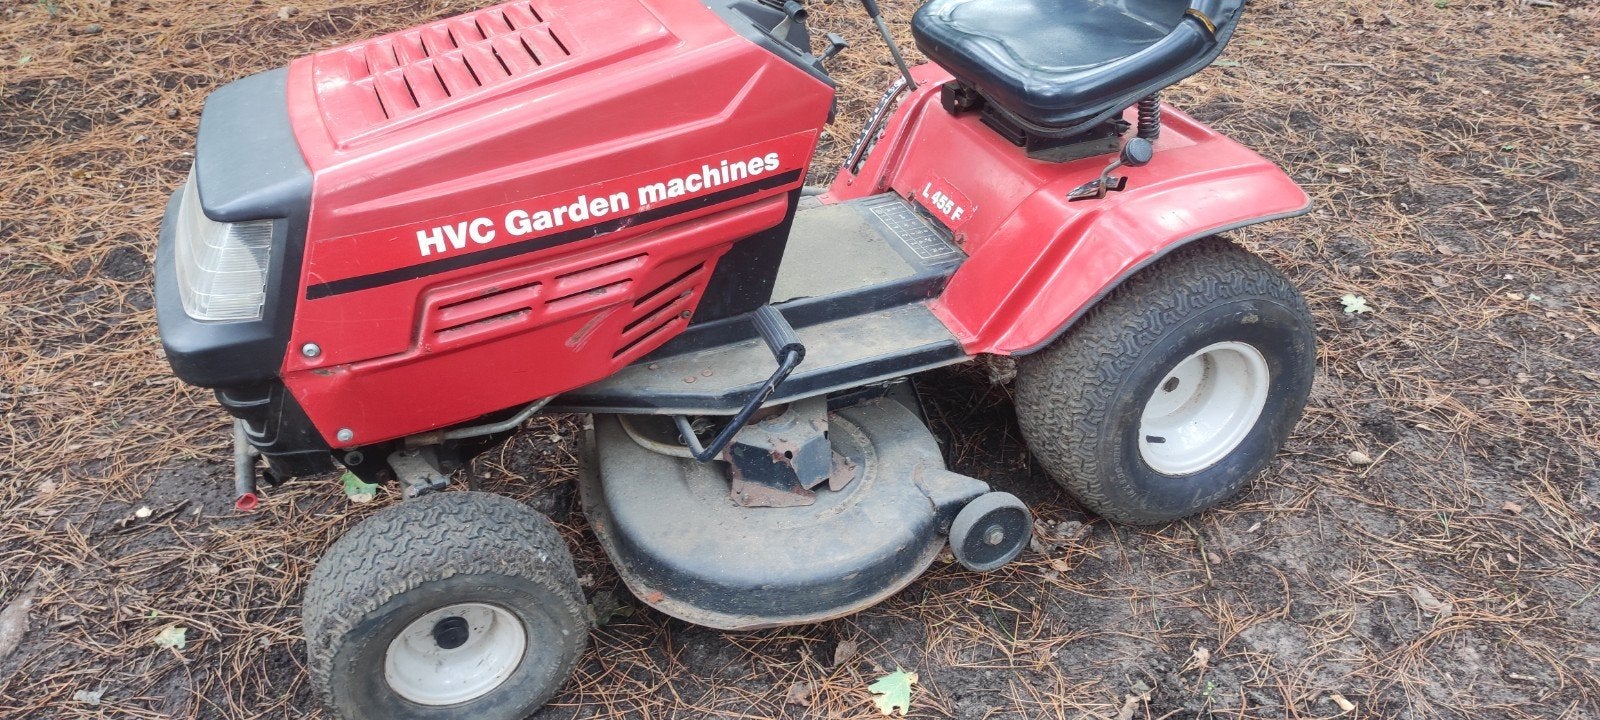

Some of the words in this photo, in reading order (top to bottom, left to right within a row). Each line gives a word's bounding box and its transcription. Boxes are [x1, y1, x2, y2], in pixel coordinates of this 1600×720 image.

[415, 217, 496, 257] HVC
[504, 191, 630, 236] Garden
[637, 151, 780, 206] machines
[922, 181, 933, 199] L
[930, 190, 955, 215] 455
[950, 206, 964, 221] F
